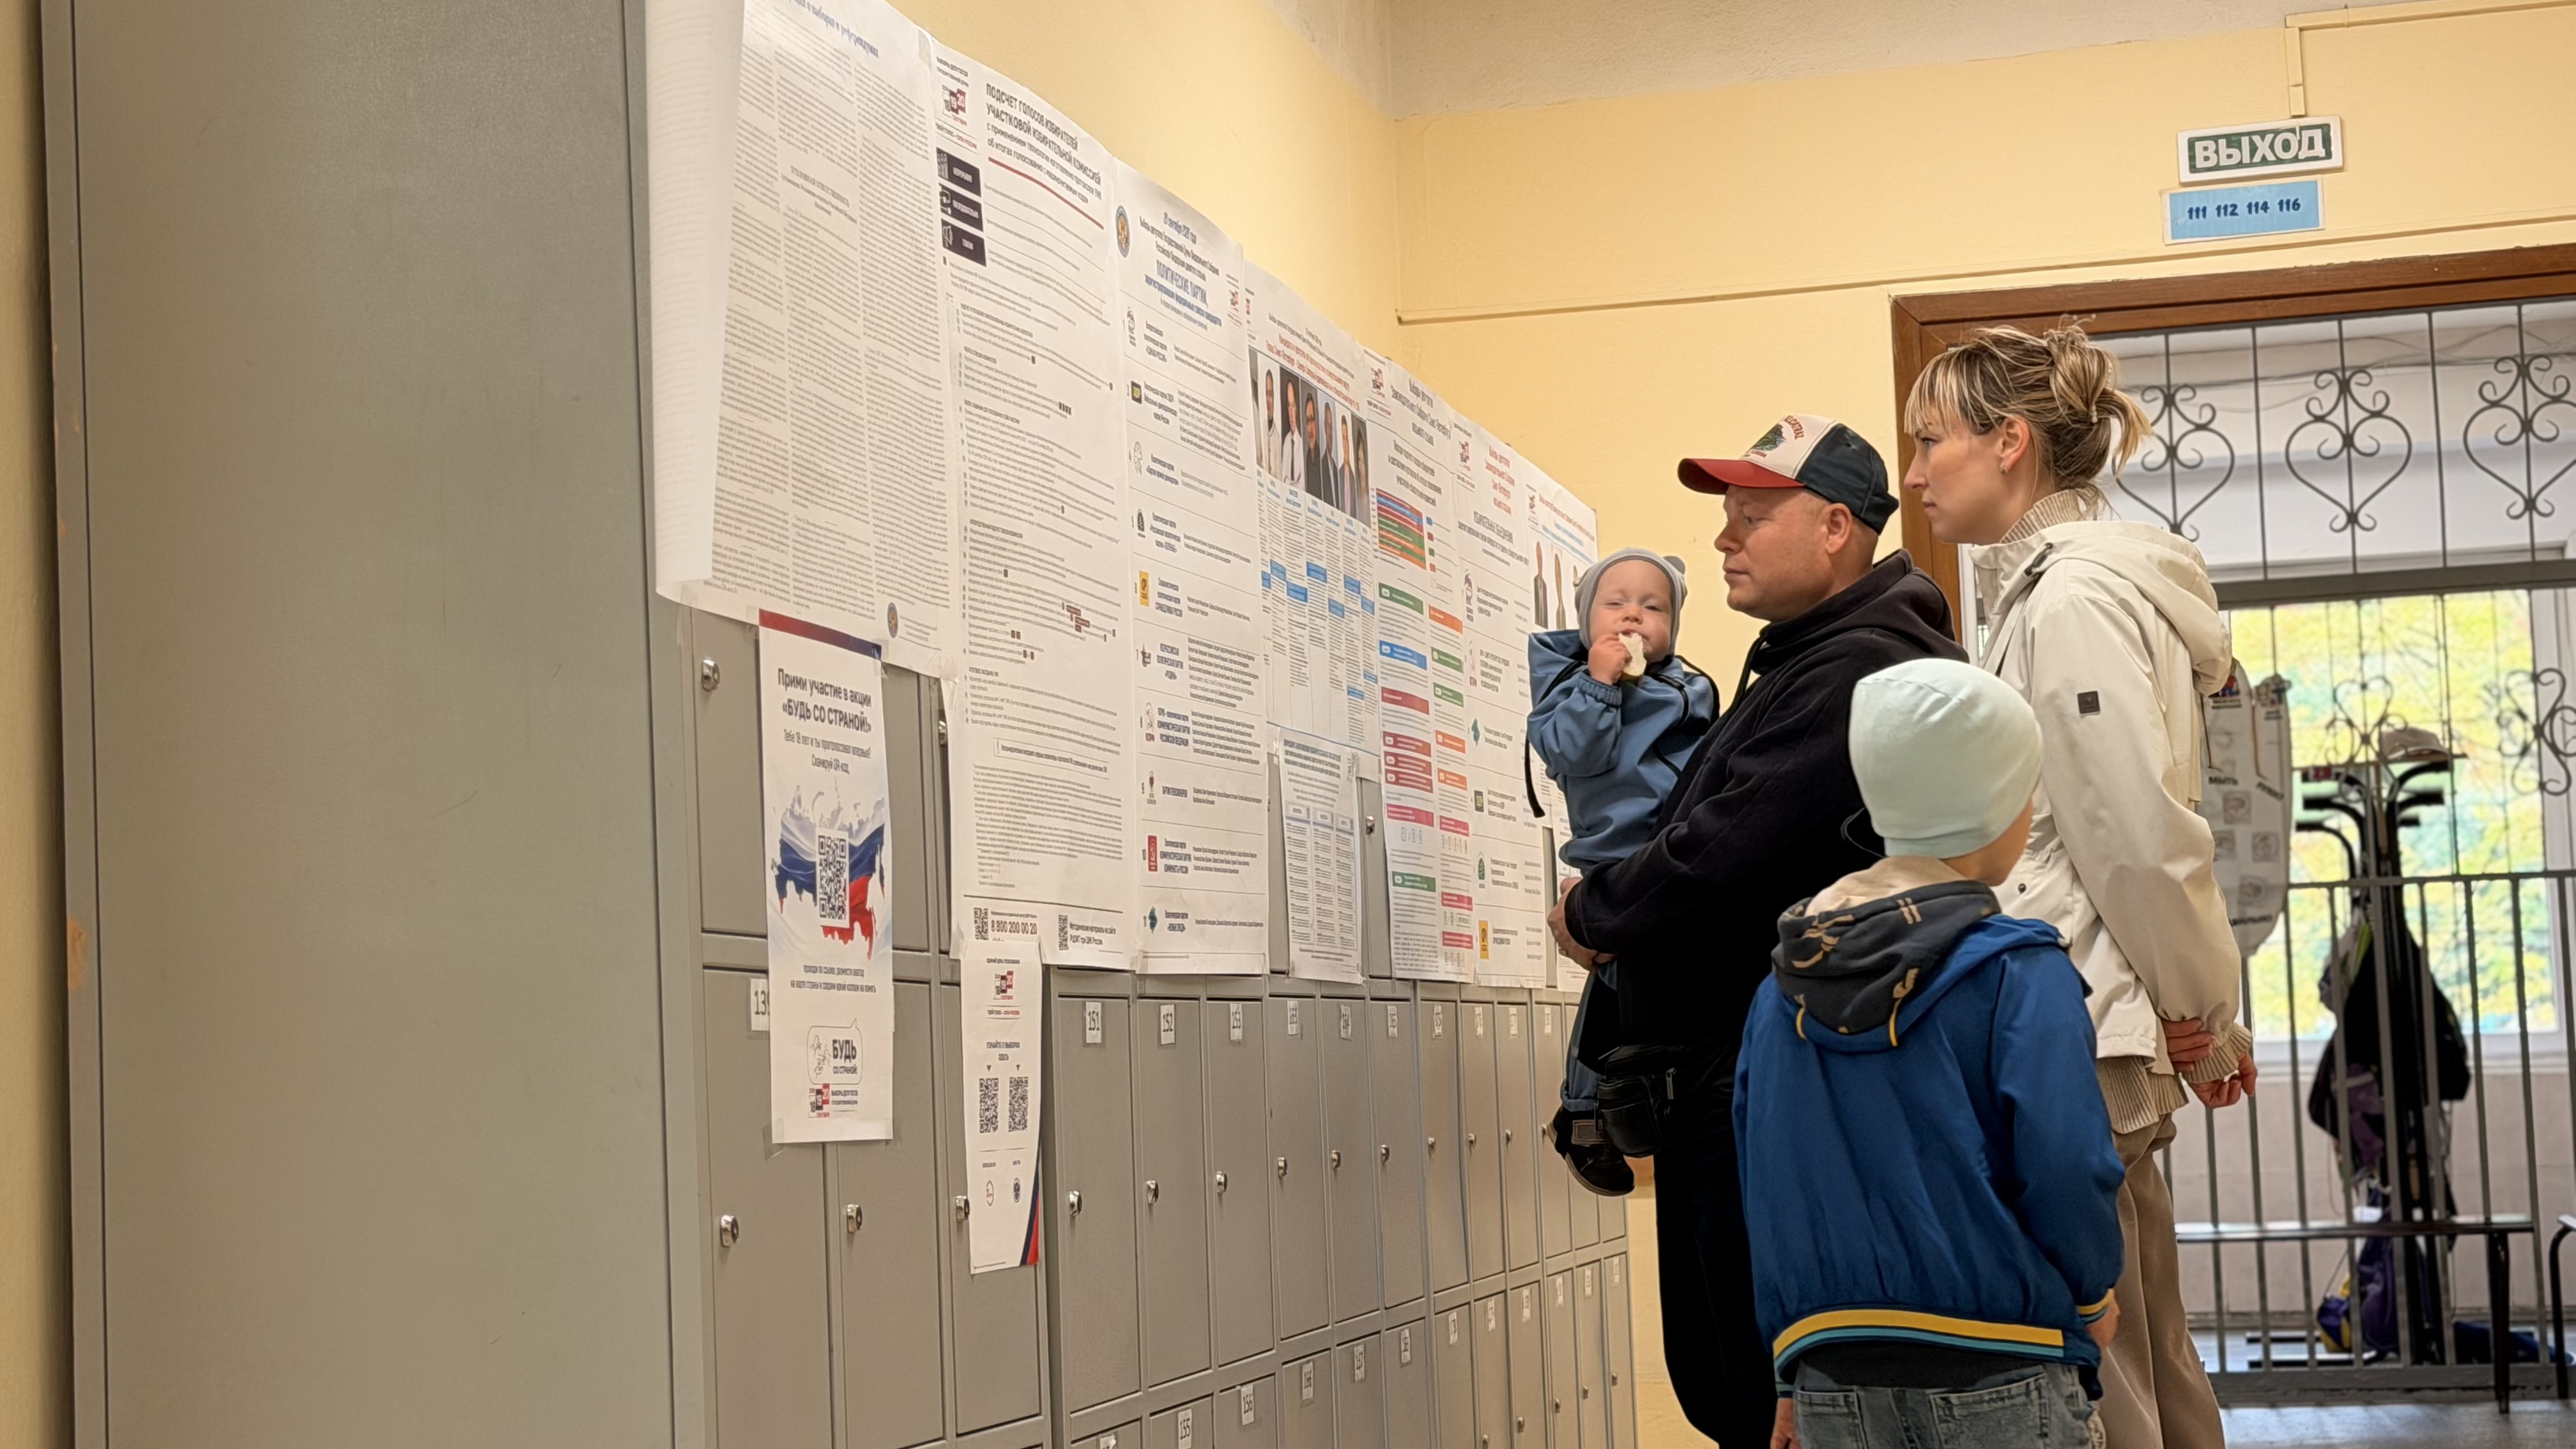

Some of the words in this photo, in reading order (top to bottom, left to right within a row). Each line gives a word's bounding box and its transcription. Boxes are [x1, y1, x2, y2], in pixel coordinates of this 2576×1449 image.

[986, 83, 1018, 110] ПОДСЧЕТ
[1018, 100, 1045, 127] ГОЛОСОВ
[986, 102, 1032, 136] УЧАСТКОВОЙ
[2195, 128, 2326, 169] ВЫХОД
[2187, 206, 2207, 220] 111
[2215, 203, 2239, 217] 112
[2246, 201, 2269, 215] 114
[2278, 198, 2301, 212] 116
[1782, 415, 1804, 440] LCATRAZ
[778, 668, 808, 692] Прими
[808, 678, 842, 700] участие
[843, 687, 848, 701] в
[849, 689, 871, 708] акции
[782, 698, 811, 722] «БУДЬ
[813, 704, 825, 723] СО
[827, 707, 871, 733] СТРАНОЙ!»
[991, 920, 995, 933] 8
[996, 921, 1008, 933] 800
[1008, 921, 1020, 934] 200
[1021, 922, 1029, 934] 00
[1029, 922, 1038, 935] 20
[1088, 1010, 1100, 1031] 151
[1162, 1013, 1173, 1032] 152
[1232, 1011, 1241, 1029] 153
[832, 1039, 857, 1064] БУДЬ
[1243, 1393, 1252, 1414] 156
[1179, 1417, 1190, 1439] 155
